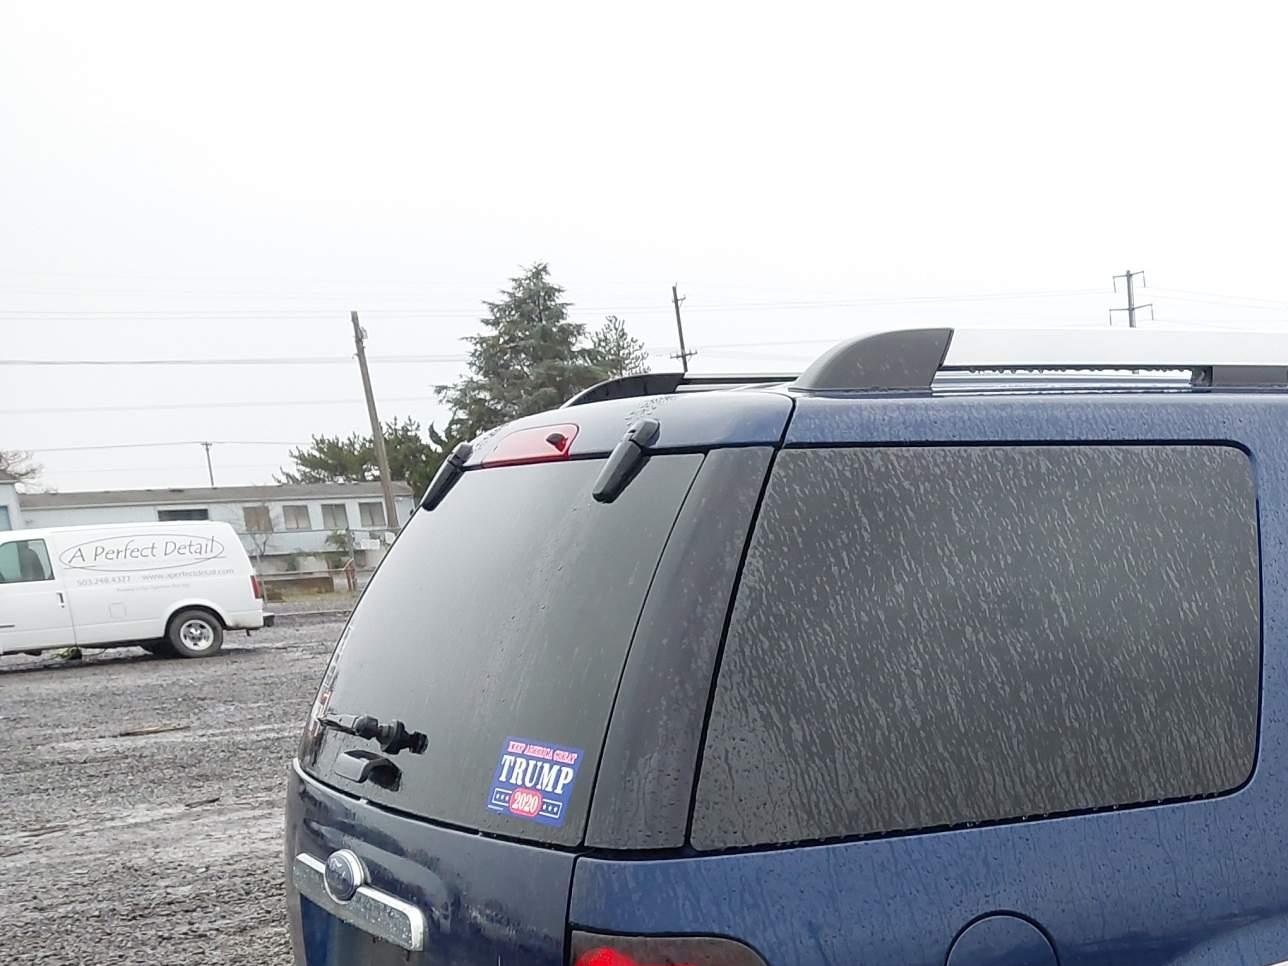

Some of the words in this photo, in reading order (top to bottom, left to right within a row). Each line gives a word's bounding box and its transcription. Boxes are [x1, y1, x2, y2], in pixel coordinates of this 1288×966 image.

[68, 548, 86, 564] A
[94, 540, 158, 561] Perfect
[164, 536, 215, 556] Detail
[524, 745, 554, 760] AMERICA
[553, 751, 577, 764] GREAT
[499, 755, 573, 794] TRUMP
[512, 792, 538, 812] 2020
